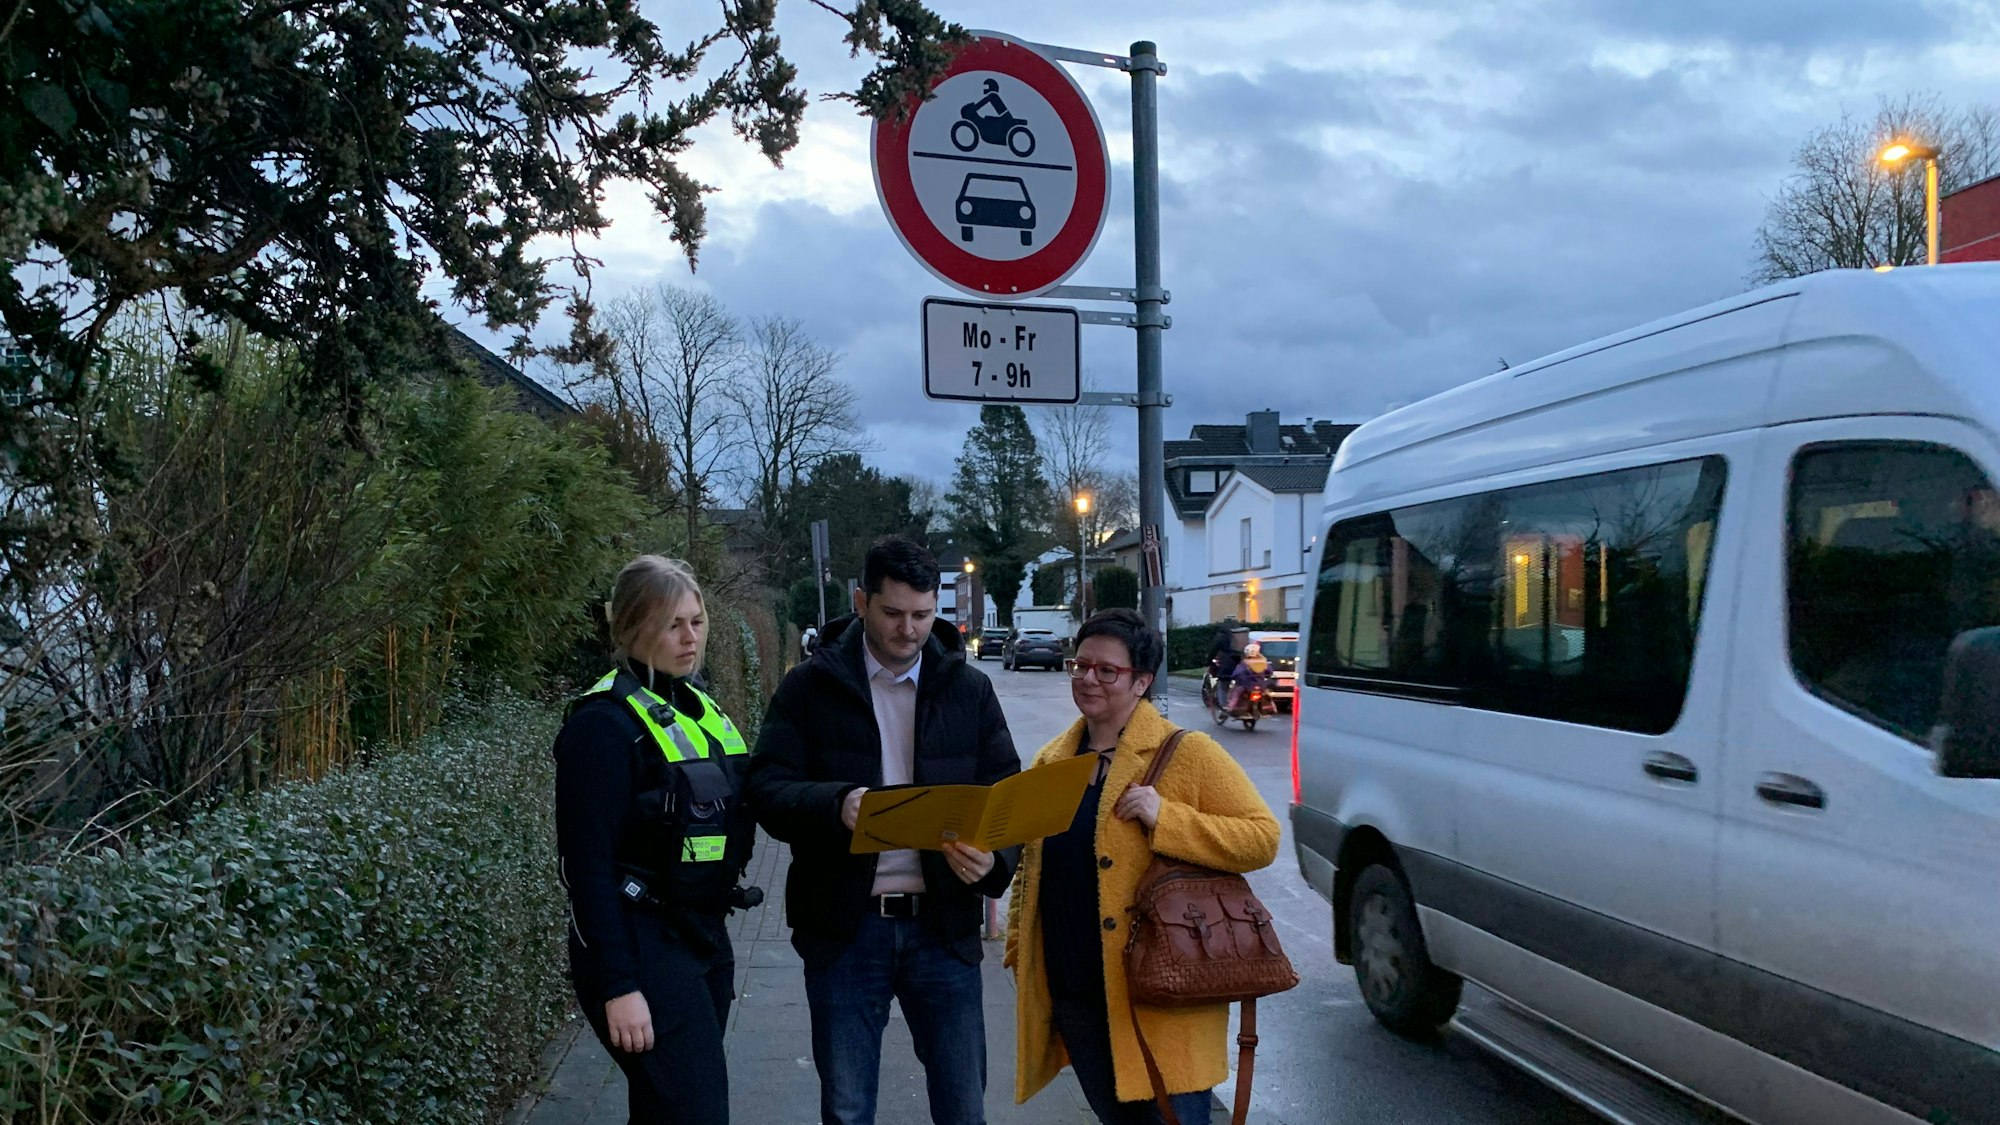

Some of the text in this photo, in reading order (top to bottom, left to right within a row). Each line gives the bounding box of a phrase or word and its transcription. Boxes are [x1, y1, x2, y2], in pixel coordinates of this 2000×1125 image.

[963, 322, 991, 349] Mo
[1015, 325, 1036, 351] Fr
[972, 361, 983, 387] 7
[1006, 362, 1031, 388] 9h
